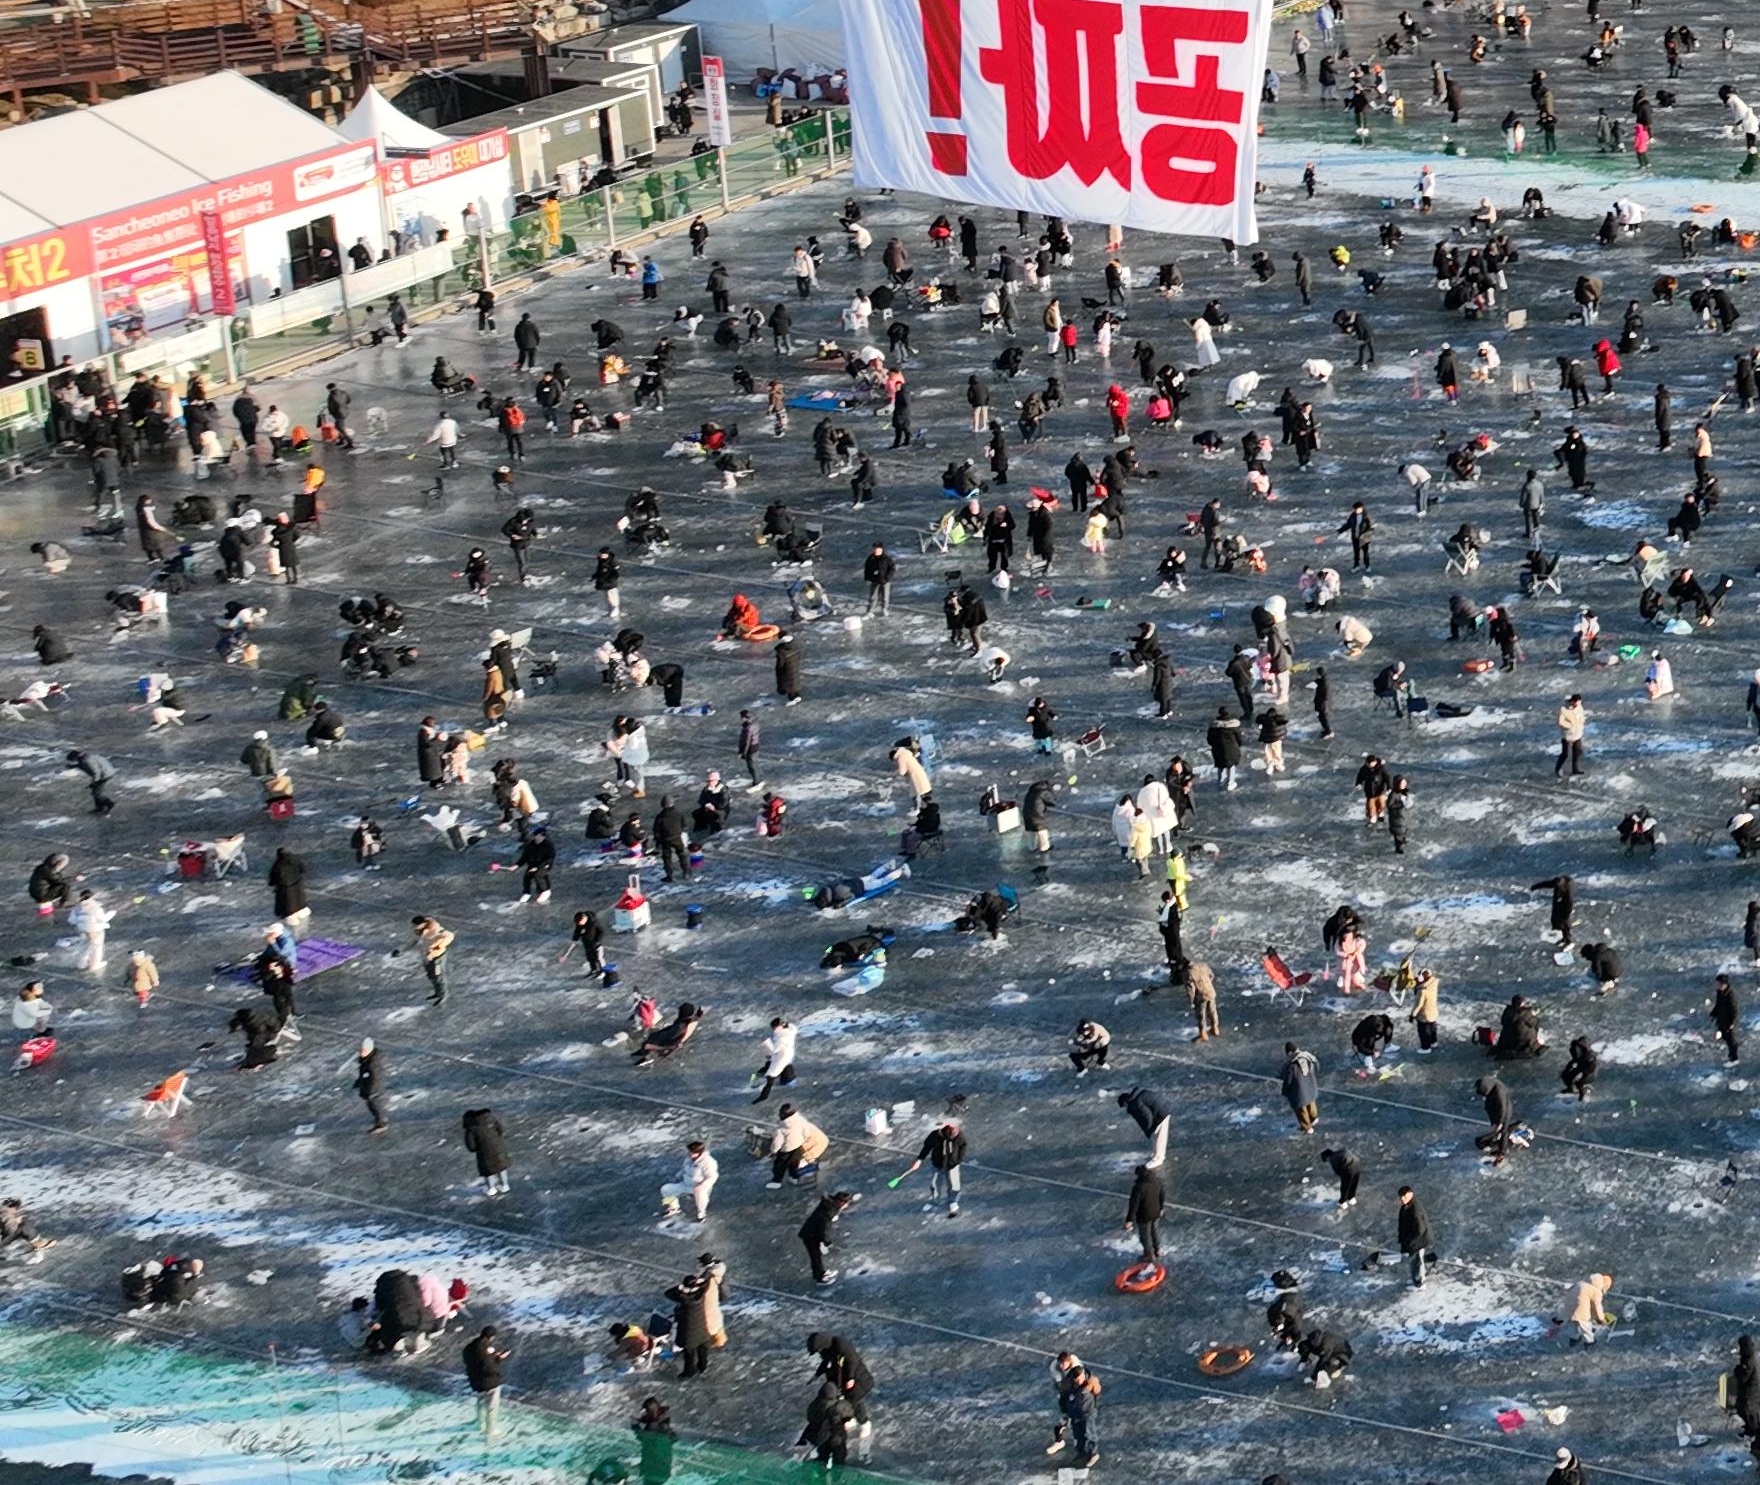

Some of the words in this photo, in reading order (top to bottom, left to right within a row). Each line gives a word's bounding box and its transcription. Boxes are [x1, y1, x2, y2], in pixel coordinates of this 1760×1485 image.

[452, 142, 478, 170] 도우미
[478, 134, 505, 161] 대기실
[92, 205, 190, 245] Sancheoneo
[191, 196, 216, 215] Ice
[216, 179, 273, 208] Fishing
[0, 237, 71, 293] 처2
